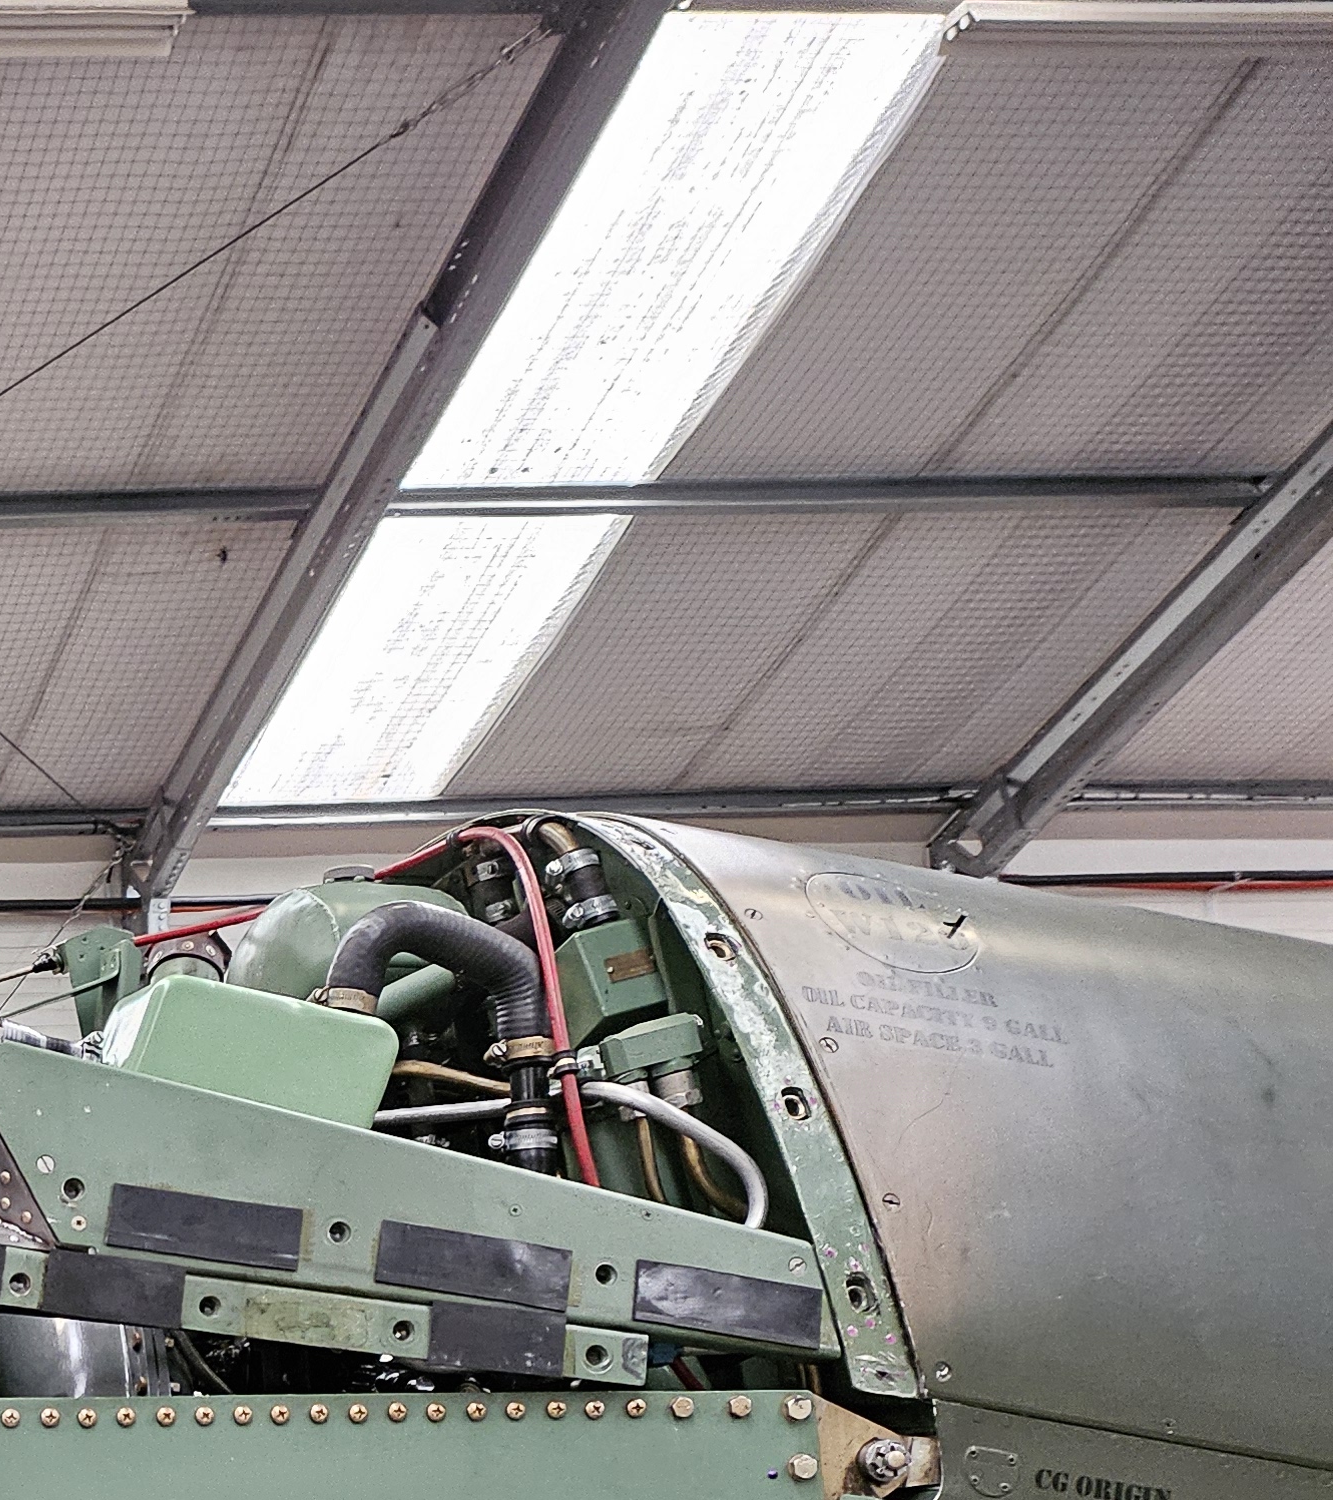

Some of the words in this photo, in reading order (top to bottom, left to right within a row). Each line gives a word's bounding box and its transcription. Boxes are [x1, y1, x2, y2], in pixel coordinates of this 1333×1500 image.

[906, 979, 998, 1008] FILLER
[801, 985, 845, 1008] OIL
[850, 994, 974, 1028] CAPACITY
[1003, 1018, 1070, 1045] GALL
[826, 1015, 873, 1039] AIR
[879, 1023, 963, 1052] SPACE
[989, 1040, 1054, 1068] GALL
[1035, 1469, 1069, 1492] CG
